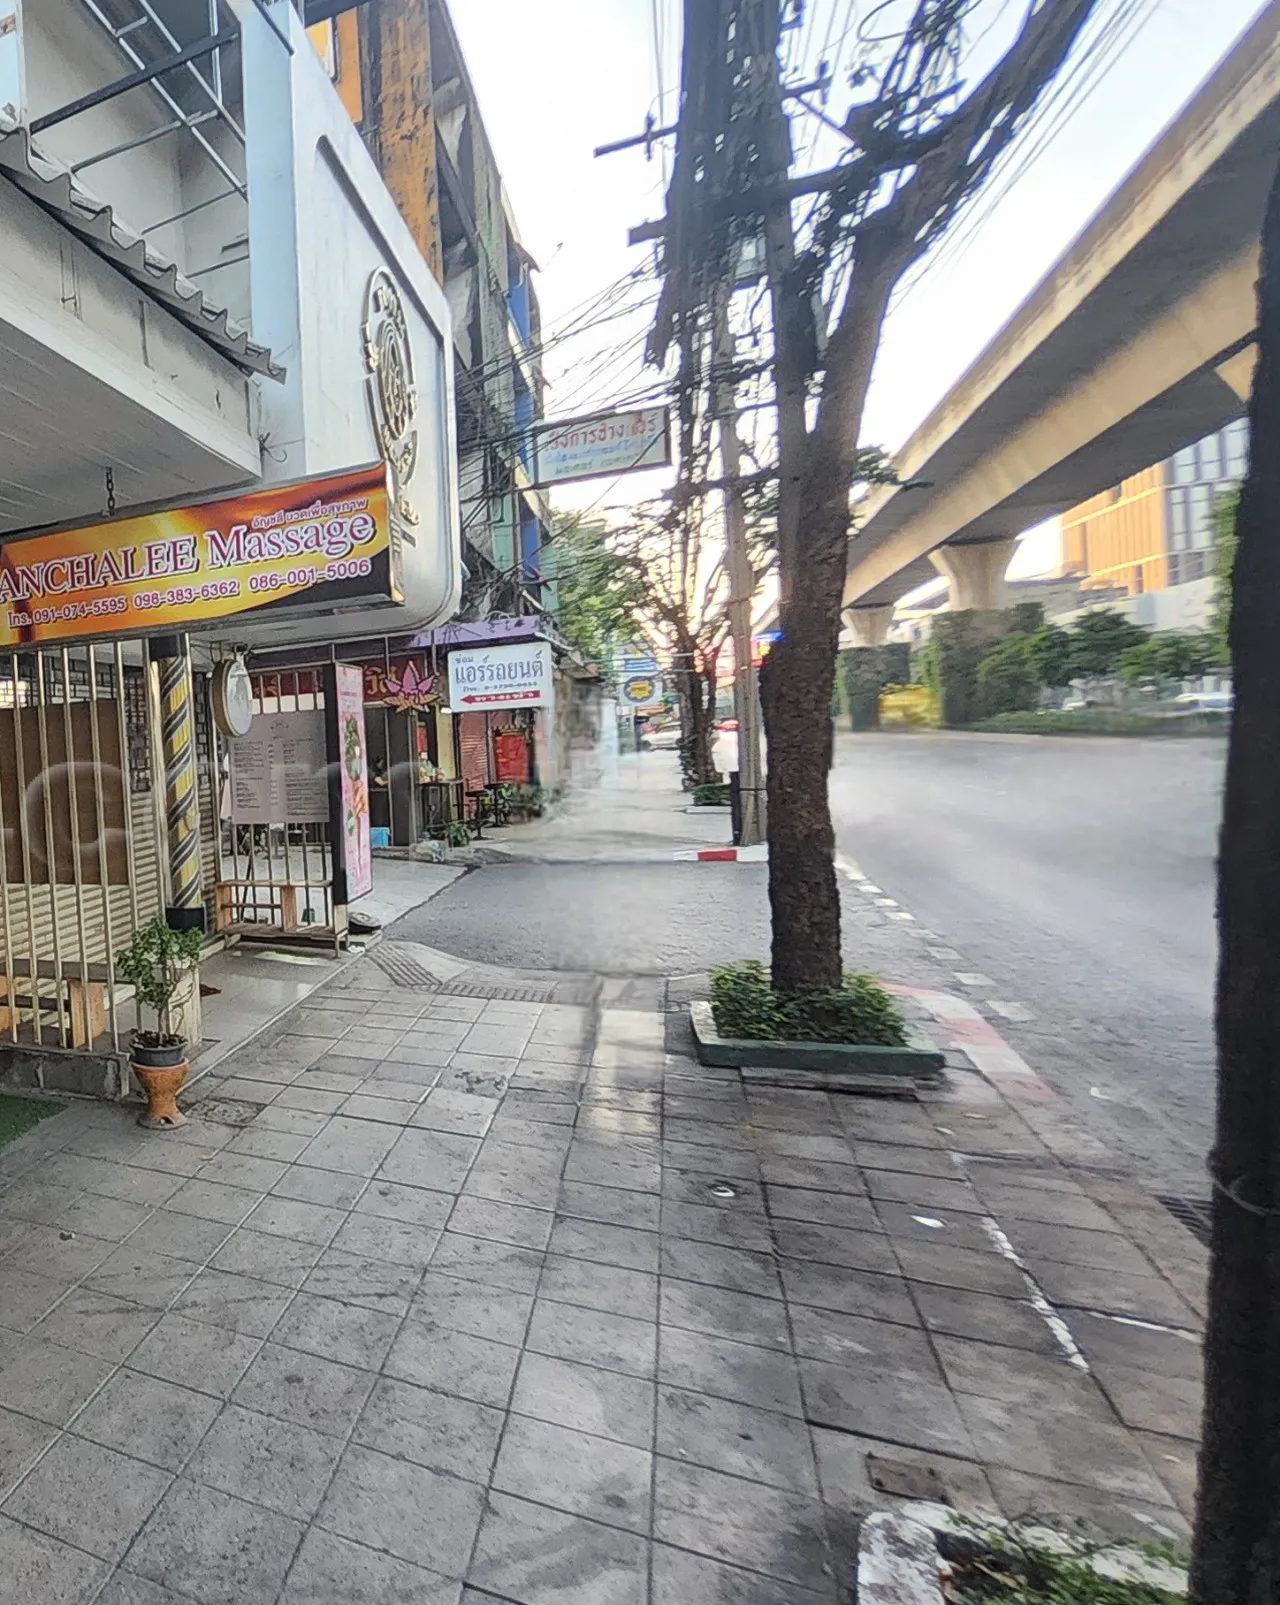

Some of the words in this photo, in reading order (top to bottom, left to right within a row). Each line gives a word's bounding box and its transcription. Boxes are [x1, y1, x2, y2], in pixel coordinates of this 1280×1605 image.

[252, 510, 285, 529] อัญชลี
[286, 499, 369, 523] นวดเพื่อสุขภาพ
[207, 513, 376, 567] Massage
[34, 597, 126, 623] 091-074-5595
[134, 580, 239, 609] 098-383-6362
[249, 559, 372, 590] 086-001-5006
[455, 650, 544, 684] แอร์รถยนต์
